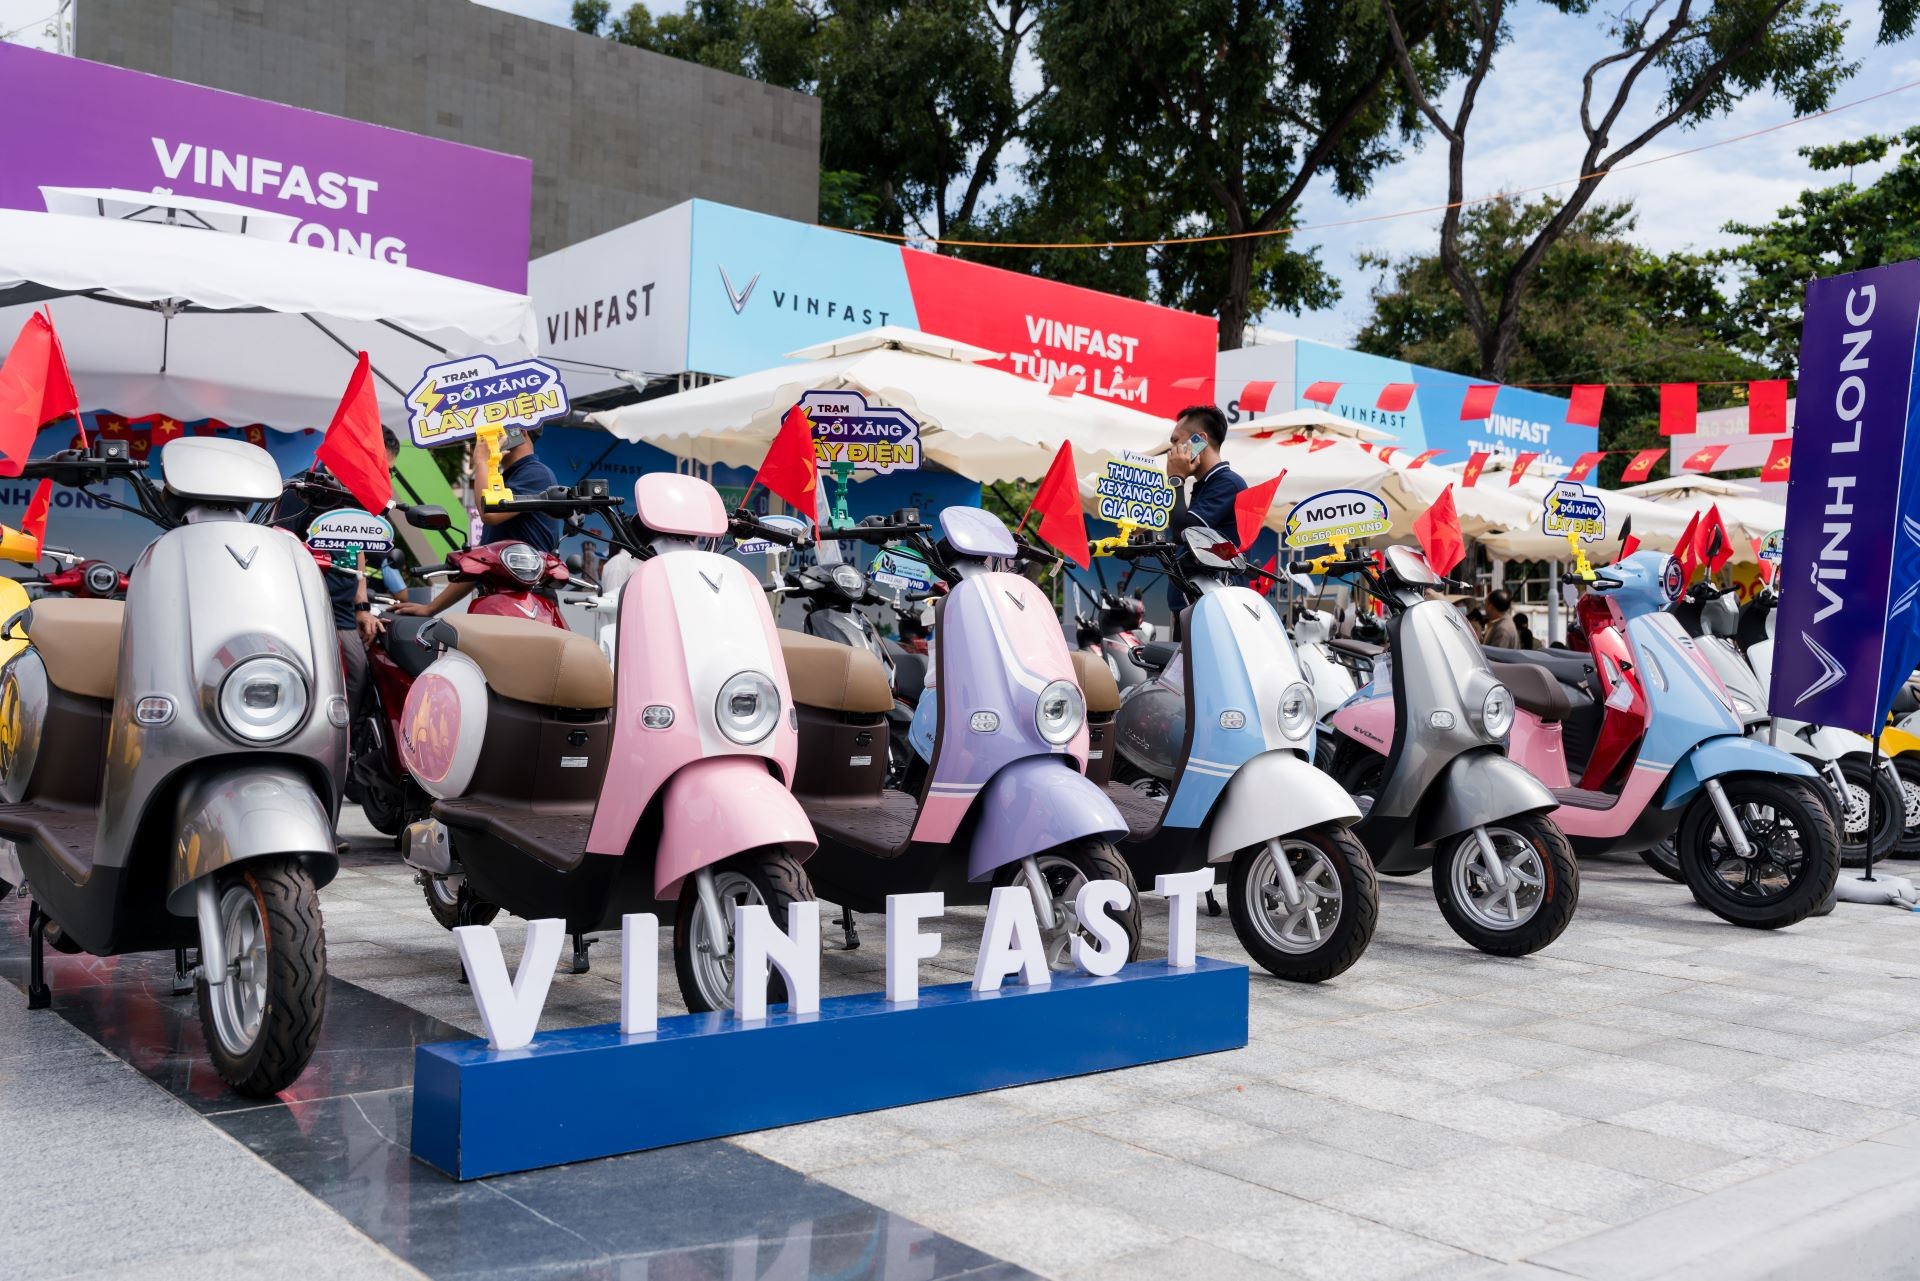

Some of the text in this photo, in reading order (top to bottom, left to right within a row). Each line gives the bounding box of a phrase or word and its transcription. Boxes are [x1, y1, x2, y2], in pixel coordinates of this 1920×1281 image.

[152, 137, 378, 214] VINFAST
[296, 222, 408, 268] ONG
[547, 282, 655, 344] VINFAST
[773, 290, 890, 327] VINFAST
[1025, 315, 1139, 363] VINFAST
[442, 368, 478, 383] TRẠM
[447, 374, 542, 405] ĐỔI XĂNG
[419, 390, 559, 438] LẤY ĐIỆN
[818, 404, 850, 415] TRẠM
[1340, 404, 1407, 429] VINFAST
[818, 418, 902, 436] ĐỔI XĂNG
[1484, 414, 1551, 445] VINFAST
[813, 436, 914, 468] ẤY ĐIỆN
[1131, 455, 1155, 465] VINFAST
[1810, 284, 1877, 624] VĨNH LONG
[1107, 463, 1164, 489] THU MUA
[1098, 480, 1173, 507] XE XĂNG CŨ
[1101, 499, 1166, 526] GIÁ CAO
[1306, 502, 1366, 522] MOTIO
[1547, 513, 1572, 532] LẤY
[1575, 504, 1598, 516] XĂNG
[321, 524, 383, 535] KLARA NEO
[452, 867, 1215, 1050] VINFAST
